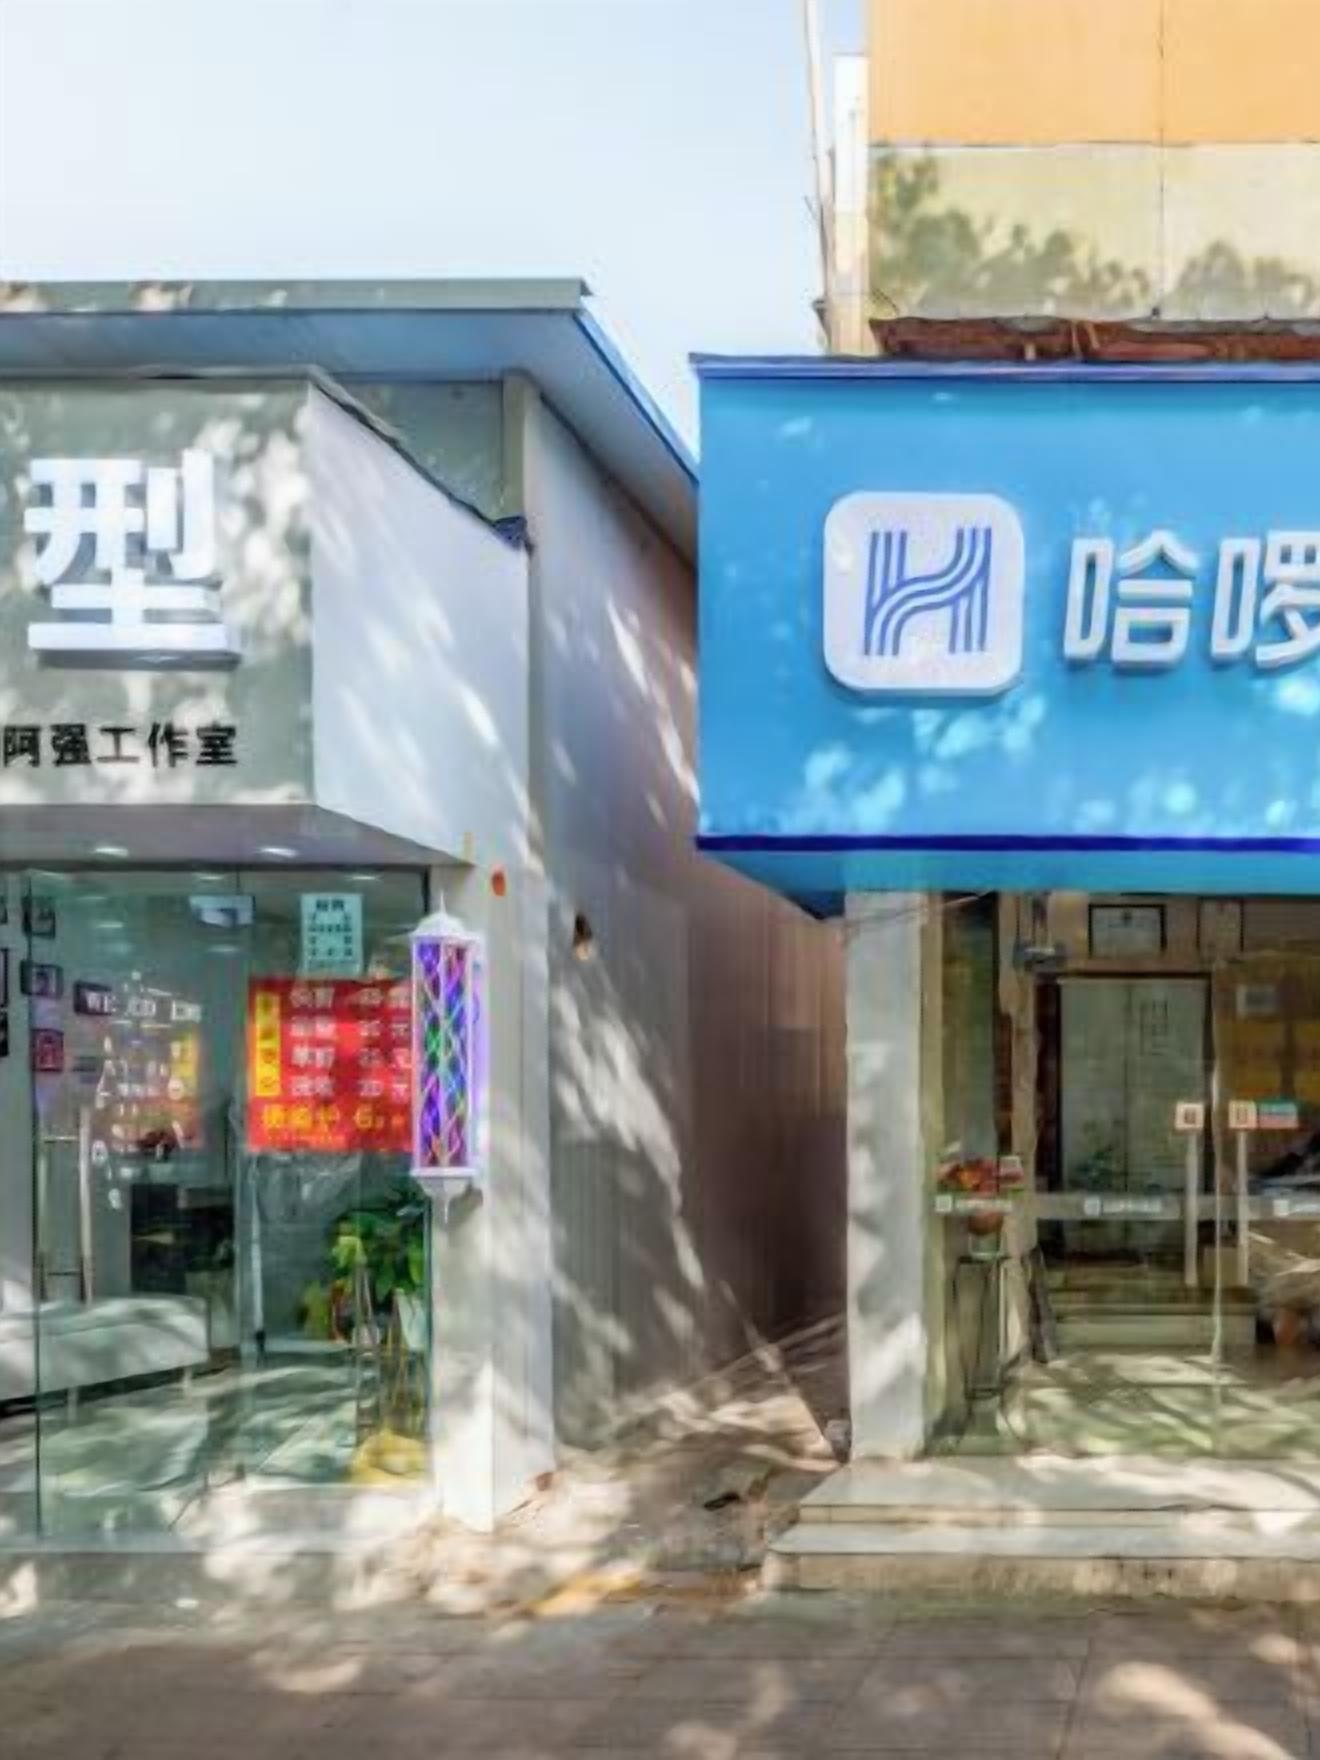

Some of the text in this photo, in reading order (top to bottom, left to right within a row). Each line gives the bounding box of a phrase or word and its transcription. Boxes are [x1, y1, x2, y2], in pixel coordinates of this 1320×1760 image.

[23, 448, 230, 652] 型
[3, 721, 239, 768] 阿强工作室
